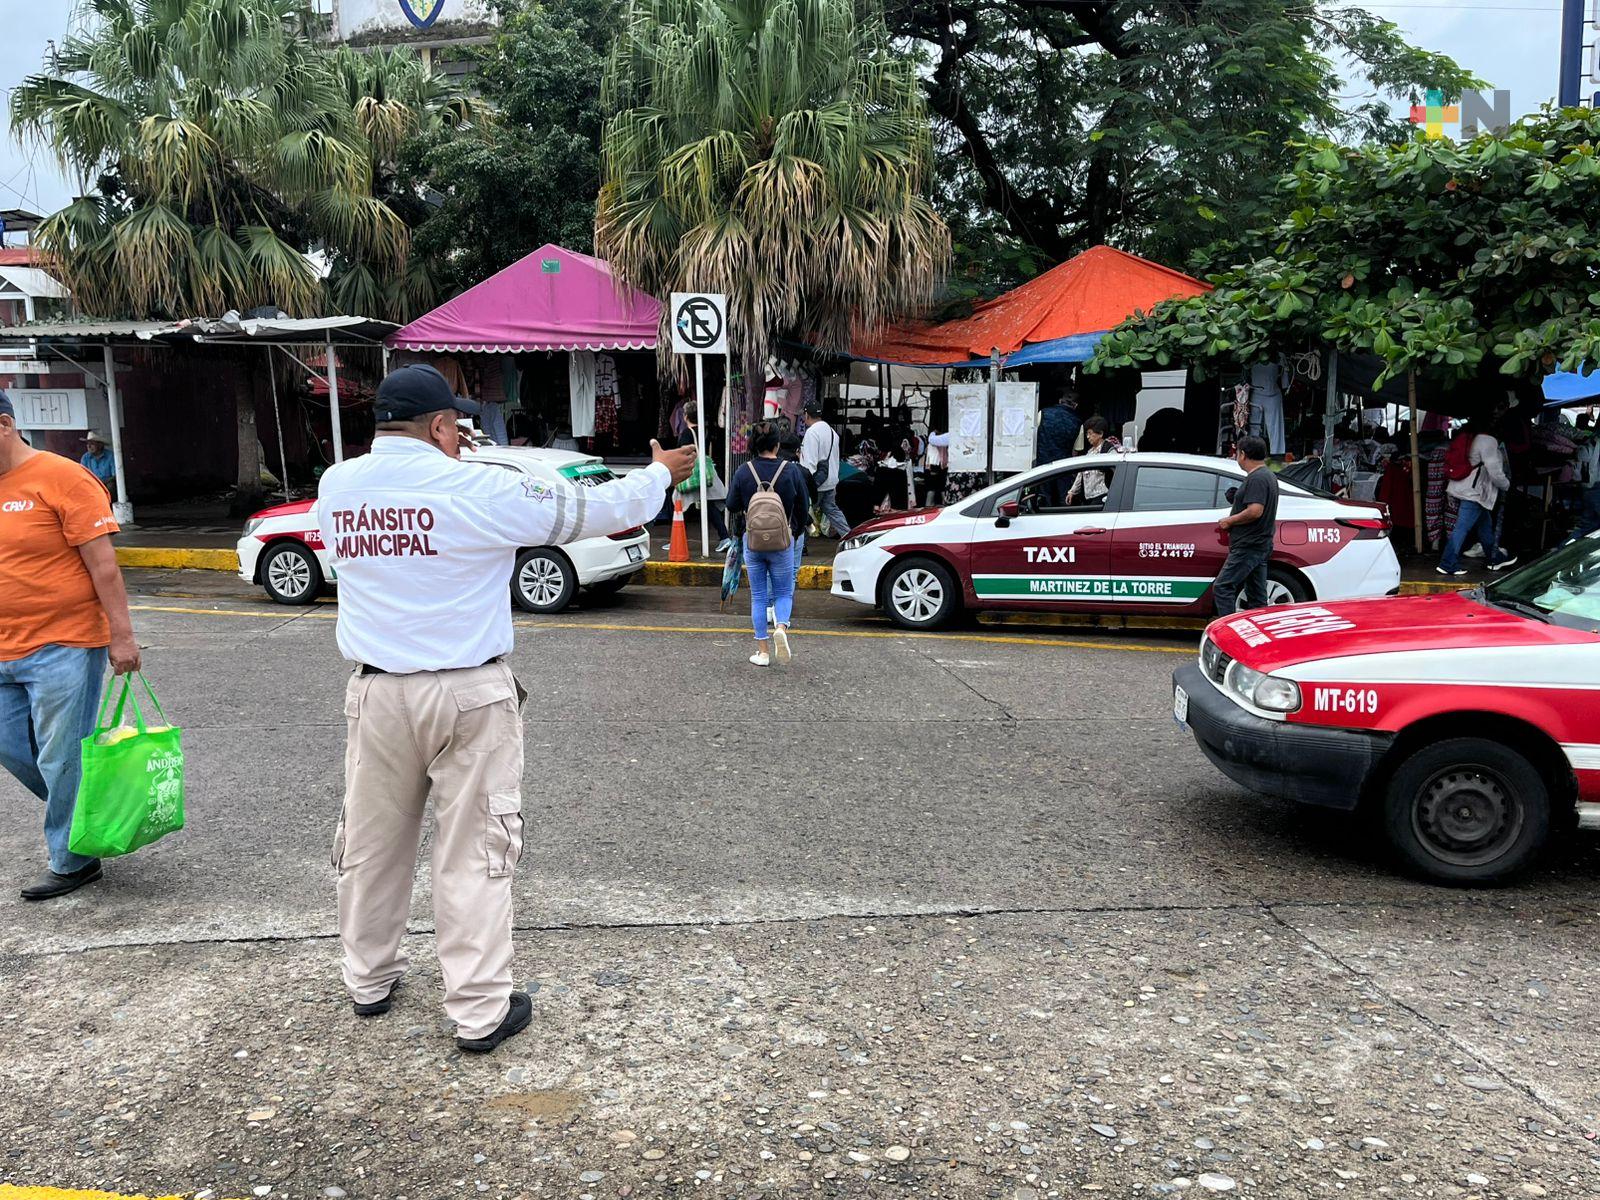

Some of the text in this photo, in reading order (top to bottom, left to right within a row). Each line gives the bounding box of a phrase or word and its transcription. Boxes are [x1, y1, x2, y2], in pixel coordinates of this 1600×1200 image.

[332, 503, 434, 533] TRÁNSITO
[1307, 527, 1341, 543] MT-53
[335, 534, 438, 559] MUNICIPAL
[1148, 550, 1195, 558] 32 4 41 97
[1155, 542, 1162, 550] EL
[1023, 546, 1076, 563] TAXI
[1030, 580, 1172, 595] MARTINEZ DE LA TORRE
[1314, 687, 1378, 714] MT-619
